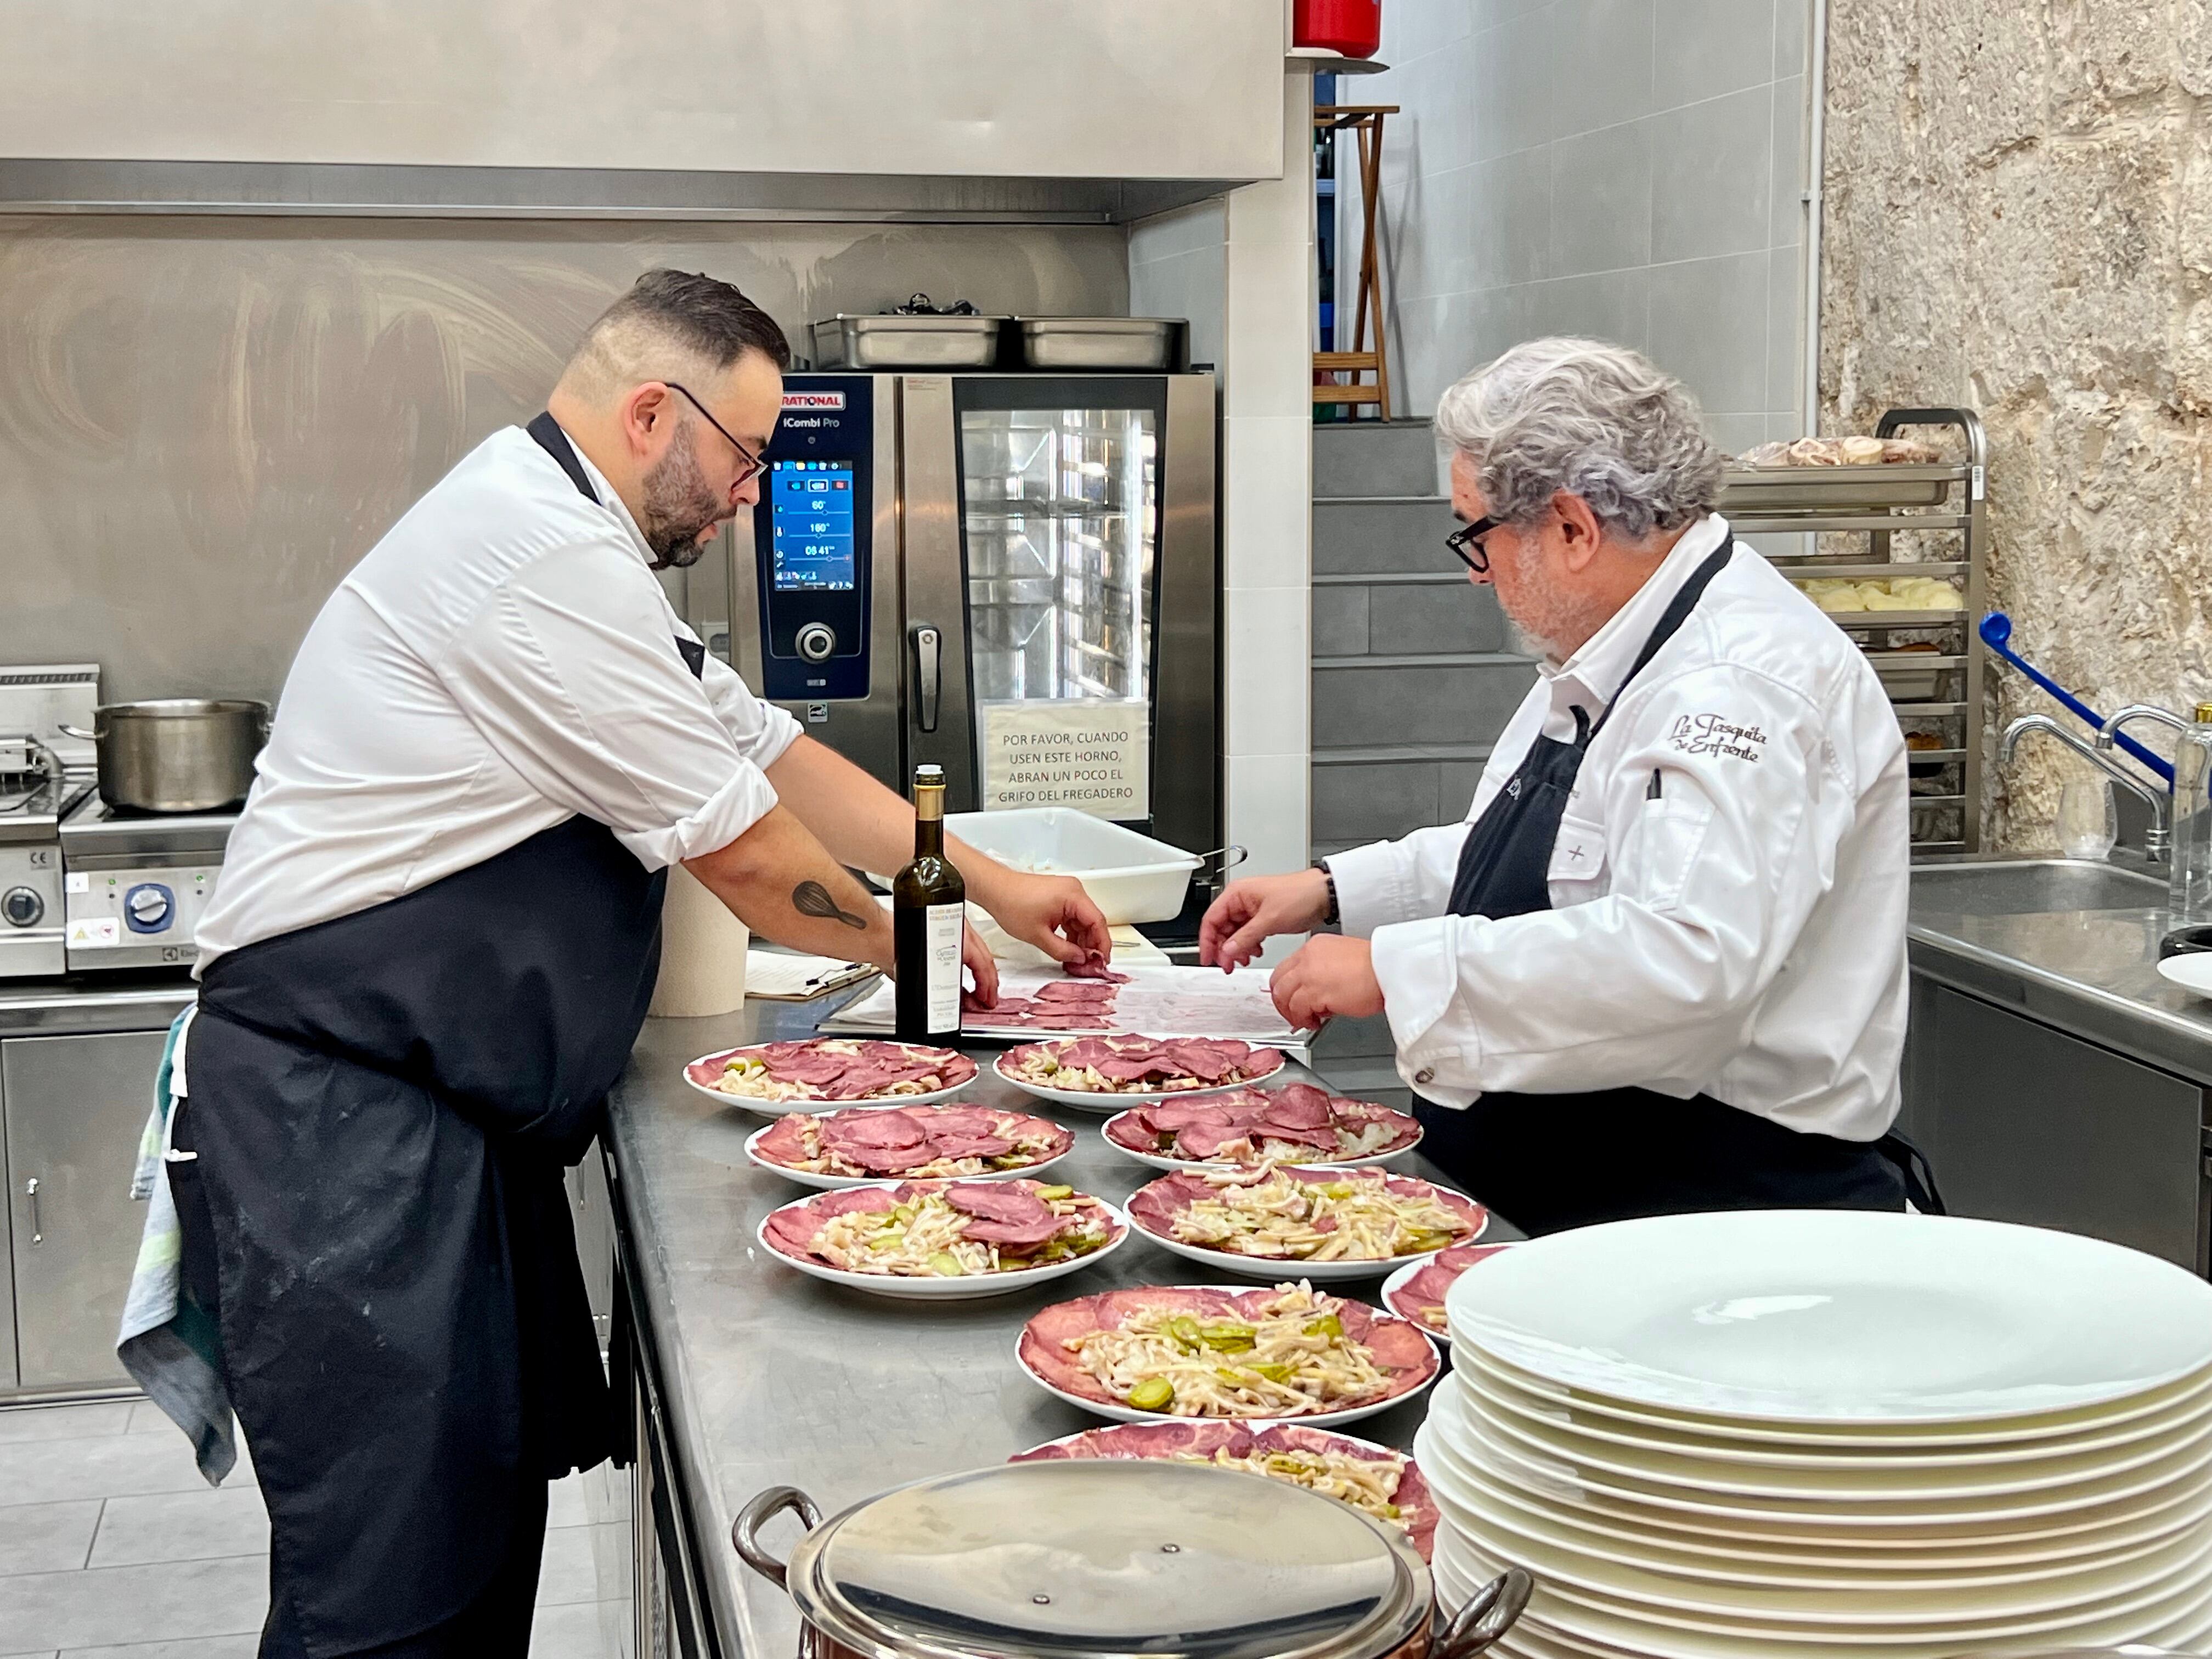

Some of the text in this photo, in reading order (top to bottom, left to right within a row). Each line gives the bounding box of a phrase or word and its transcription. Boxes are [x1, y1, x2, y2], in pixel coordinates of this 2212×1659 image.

[782, 397, 840, 405] RATIONAL
[783, 417, 840, 427] iCombi Pro
[1667, 713, 1767, 744] La Tasquita
[1003, 731, 1128, 746] POR FAVOR, CUANDO
[1688, 735, 1758, 763] Enfrente
[1010, 751, 1122, 764] USEN ESTE HORNO,
[1008, 769, 1123, 783] ABRAN UN POCO EL
[999, 787, 1133, 802] GRIFO DEL FREGADERO
